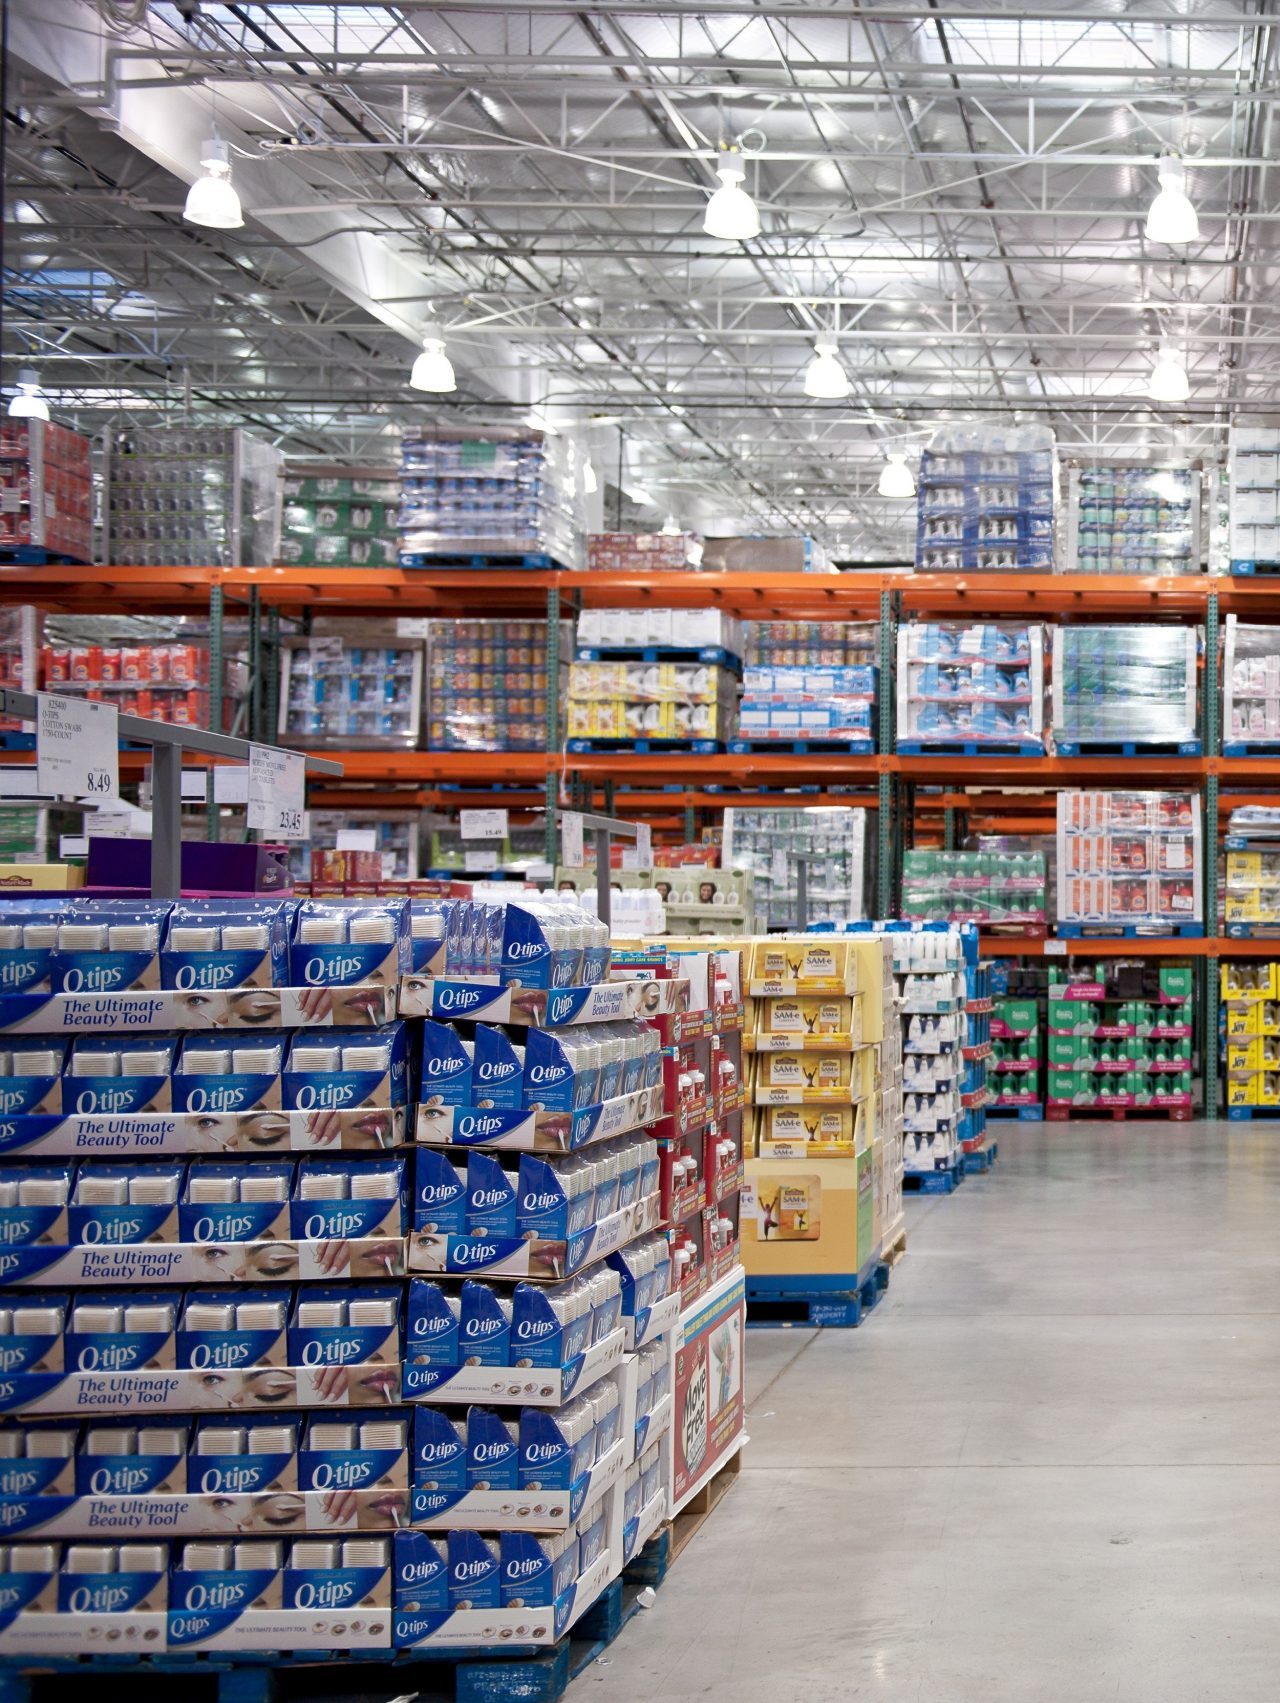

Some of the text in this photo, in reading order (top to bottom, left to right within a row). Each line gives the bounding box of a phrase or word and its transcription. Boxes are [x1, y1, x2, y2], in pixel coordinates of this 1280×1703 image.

[43, 720, 82, 732] COTTON SWABS
[88, 772, 110, 792] 8.49
[280, 812, 300, 829] 23.45
[62, 999, 164, 1013] The Ultimate
[62, 1012, 153, 1027] Beauty Tool
[81, 1251, 182, 1265] The Ultimate
[81, 1264, 172, 1279] Beauty Tool
[683, 1367, 706, 1429] Move
[686, 1399, 705, 1447] Free
